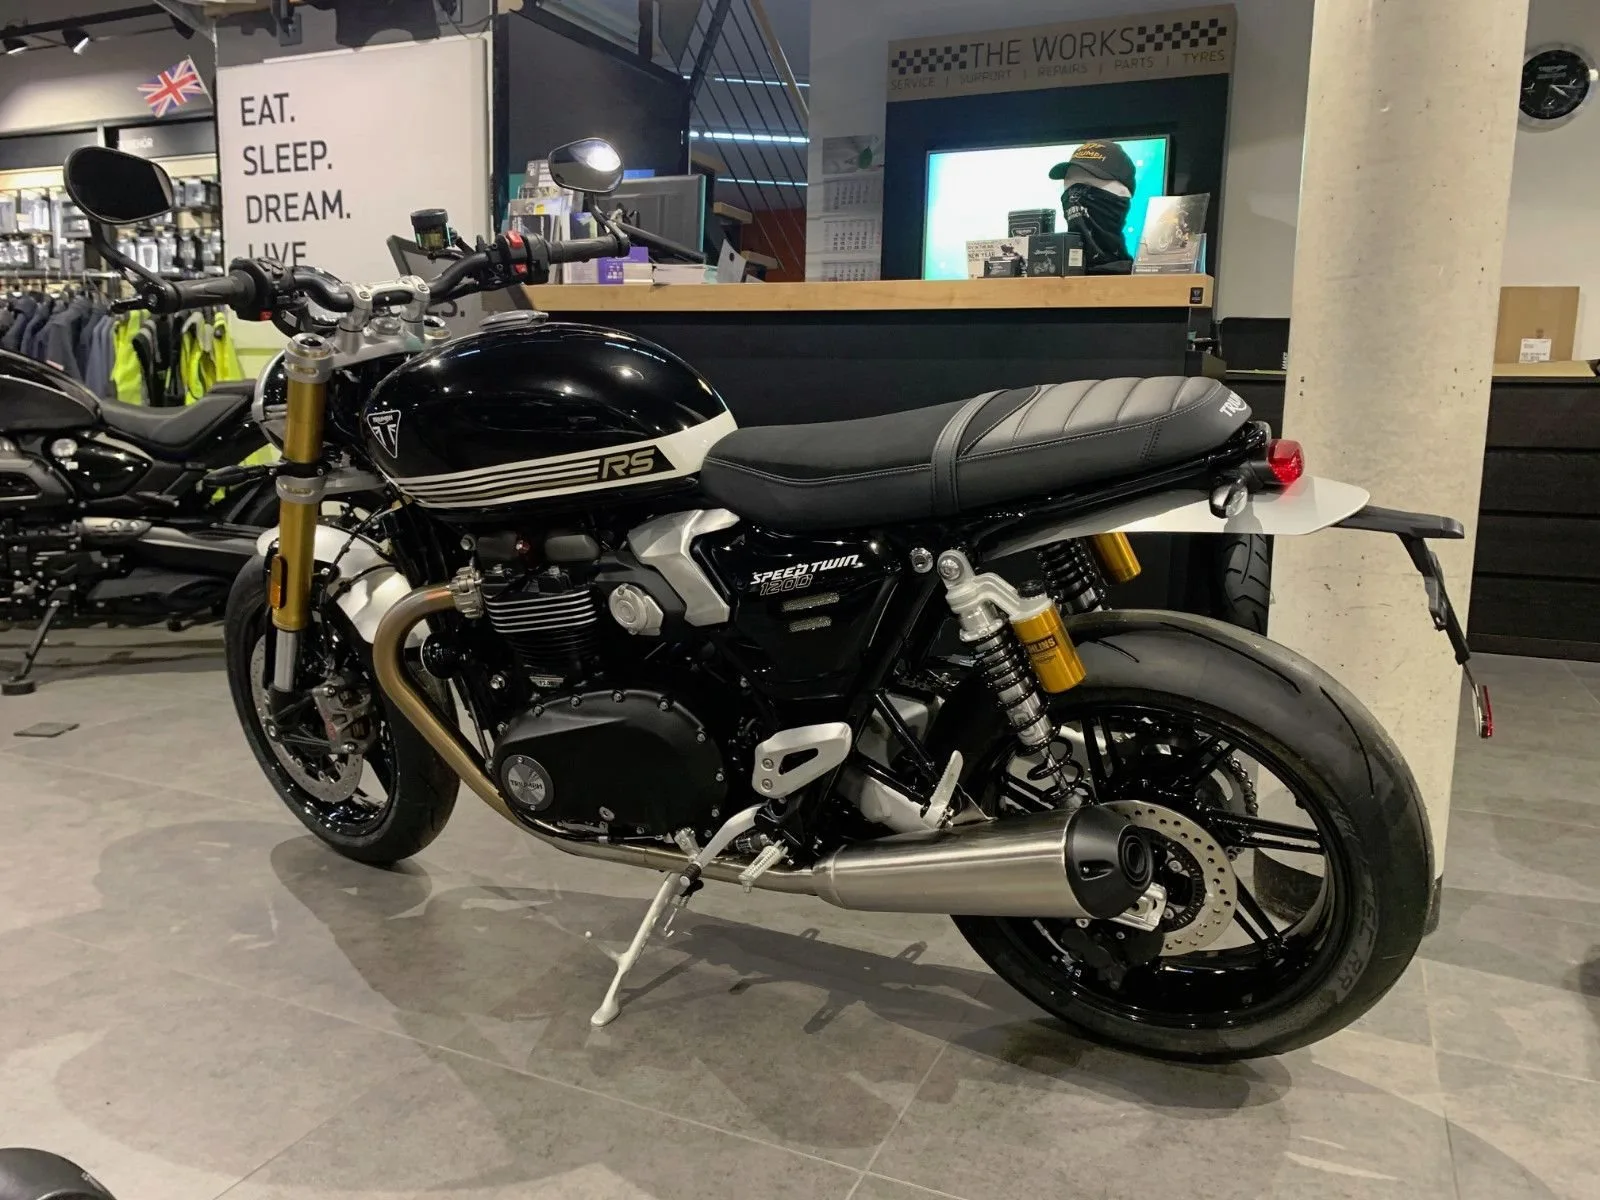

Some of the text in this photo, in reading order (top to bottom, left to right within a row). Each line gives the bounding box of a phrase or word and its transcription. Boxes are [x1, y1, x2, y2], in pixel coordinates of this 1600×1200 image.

[970, 27, 1135, 69] THE WORKS
[890, 50, 1226, 91] SERVICE SUPPORT REPAIRS PARTS TYRES
[240, 92, 296, 127] EAT.
[242, 140, 333, 176] SLEEP.
[245, 189, 351, 224] DREAM.
[602, 448, 655, 479] RS
[750, 554, 859, 585] SPEED TWIN
[760, 574, 813, 596] 1200
